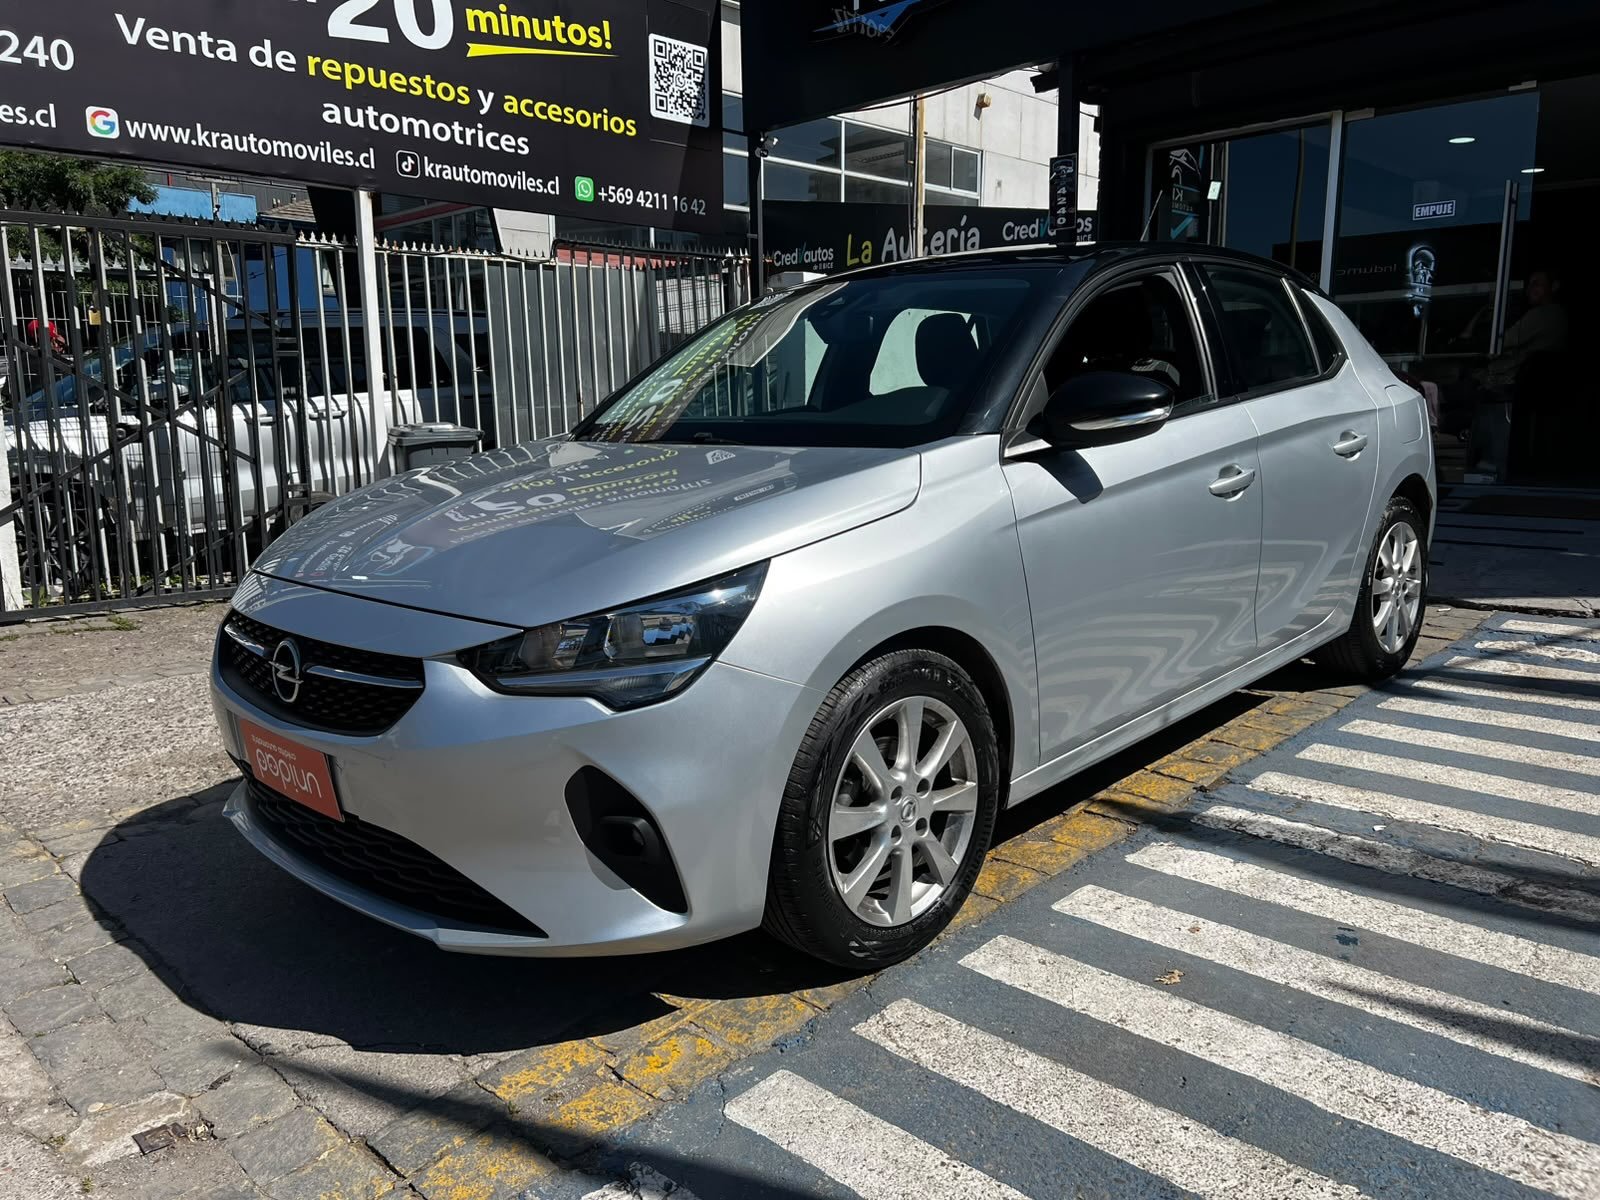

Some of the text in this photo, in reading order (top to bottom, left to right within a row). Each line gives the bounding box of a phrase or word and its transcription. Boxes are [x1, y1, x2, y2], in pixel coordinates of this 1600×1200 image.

[327, 0, 612, 50] 20 minutos!
[0, 29, 75, 71] 240
[114, 12, 637, 137] Venta de repuestos y accesorios
[0, 103, 57, 128] es.cl
[322, 102, 530, 155] automotrices
[125, 119, 375, 170] www.krautomoviles.cl
[423, 155, 560, 196] krautomoviles.cl
[597, 185, 706, 216] +569 4211 16 42
[1415, 203, 1453, 217] EMPUJE
[846, 233, 873, 267] La
[256, 748, 322, 798] unidad
